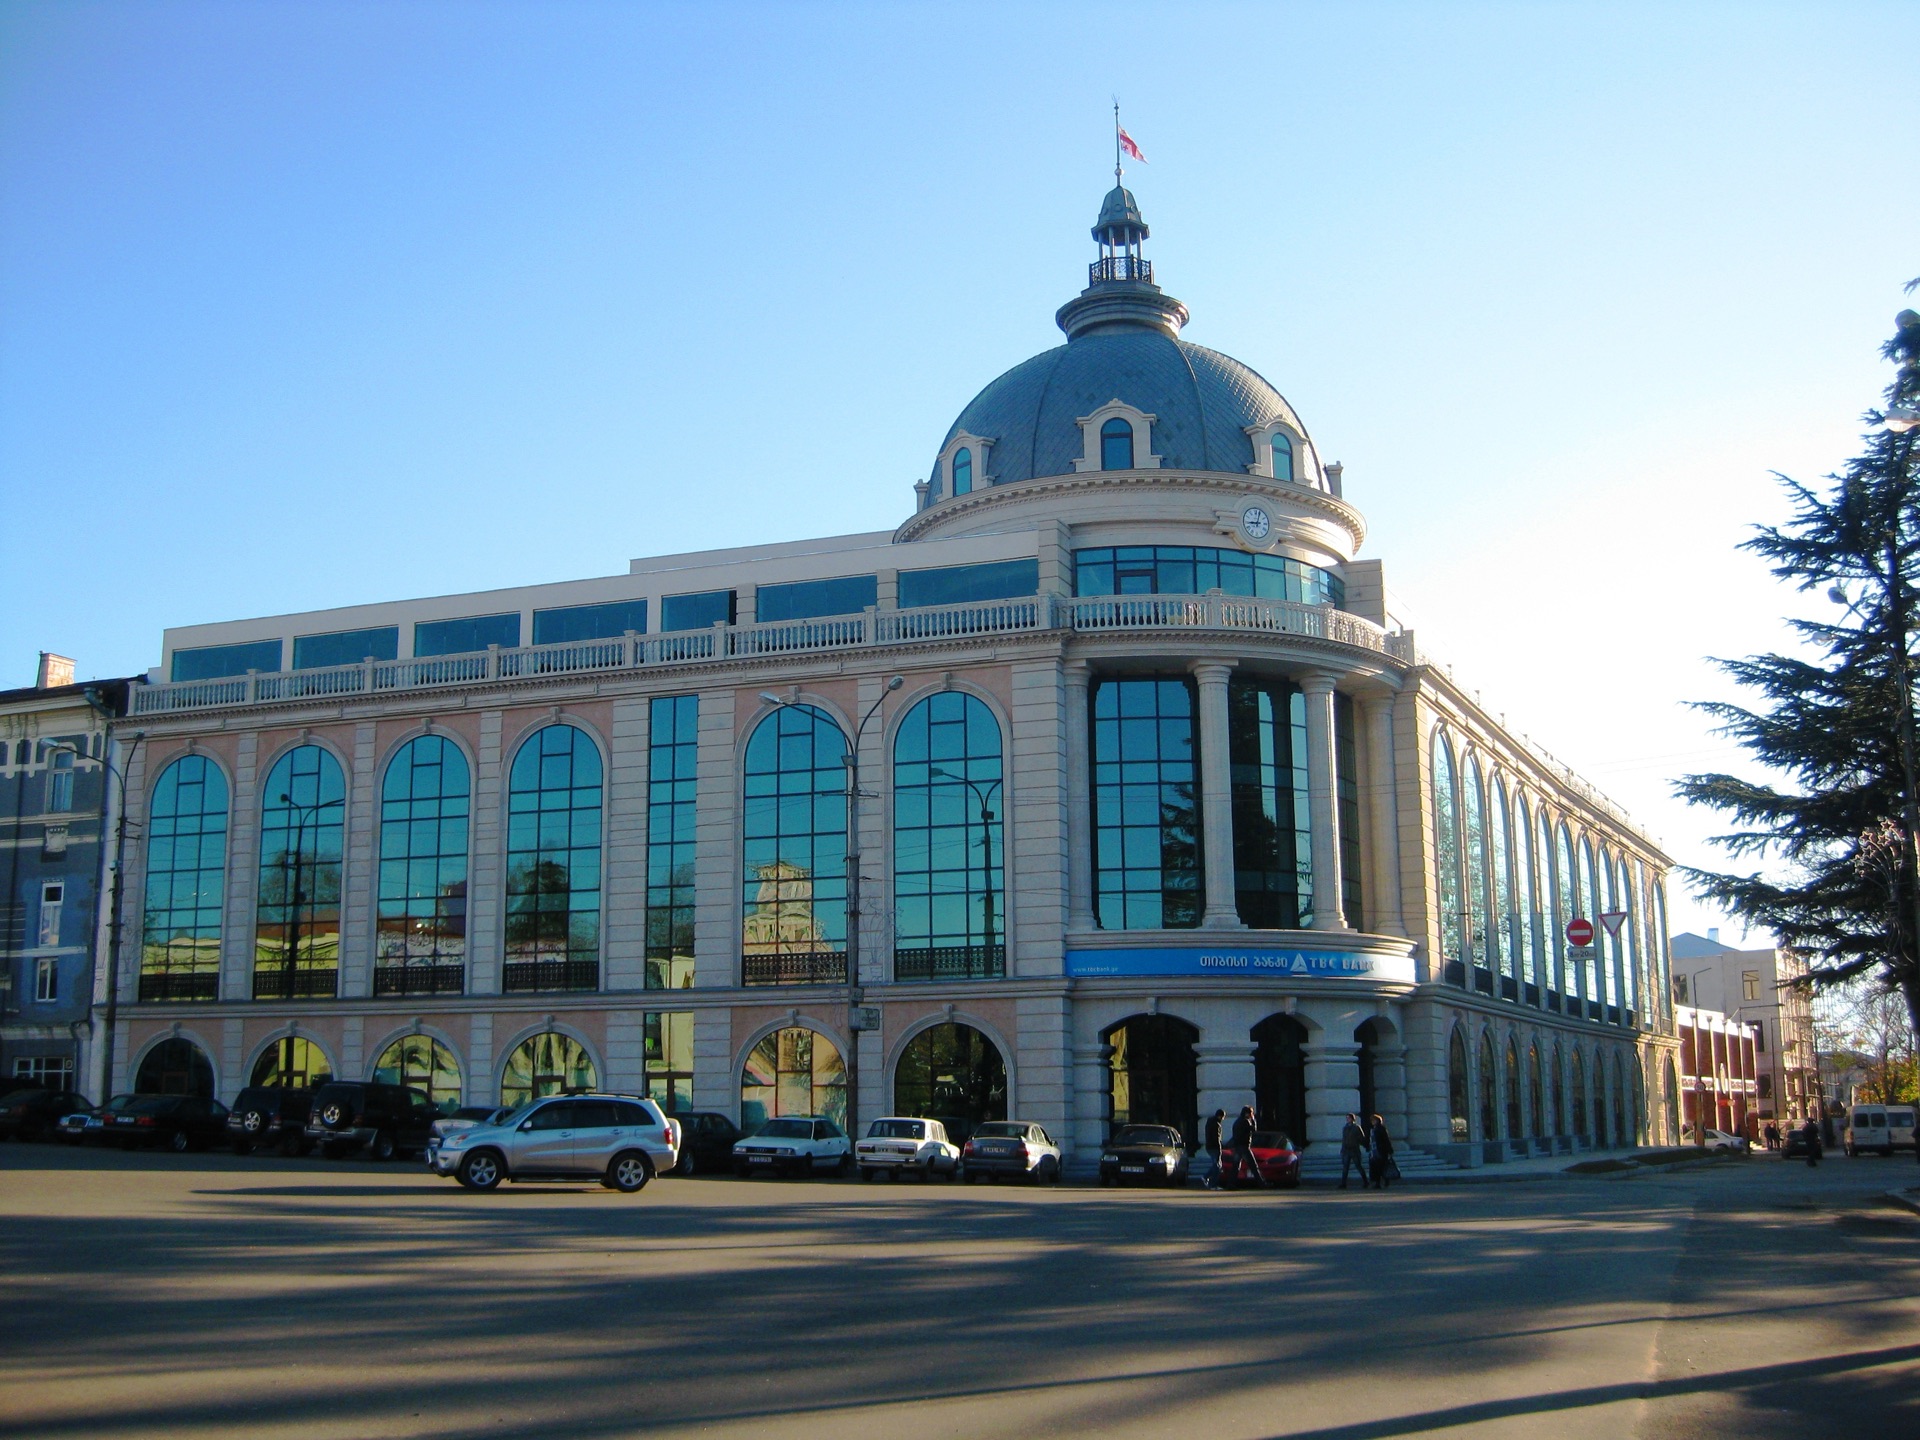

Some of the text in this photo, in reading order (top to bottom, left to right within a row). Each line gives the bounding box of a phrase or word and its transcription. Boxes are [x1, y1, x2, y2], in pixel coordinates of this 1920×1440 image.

[1200, 956, 1288, 968] თიბისი ბანკი
[1309, 957, 1375, 971] TBC BANK
